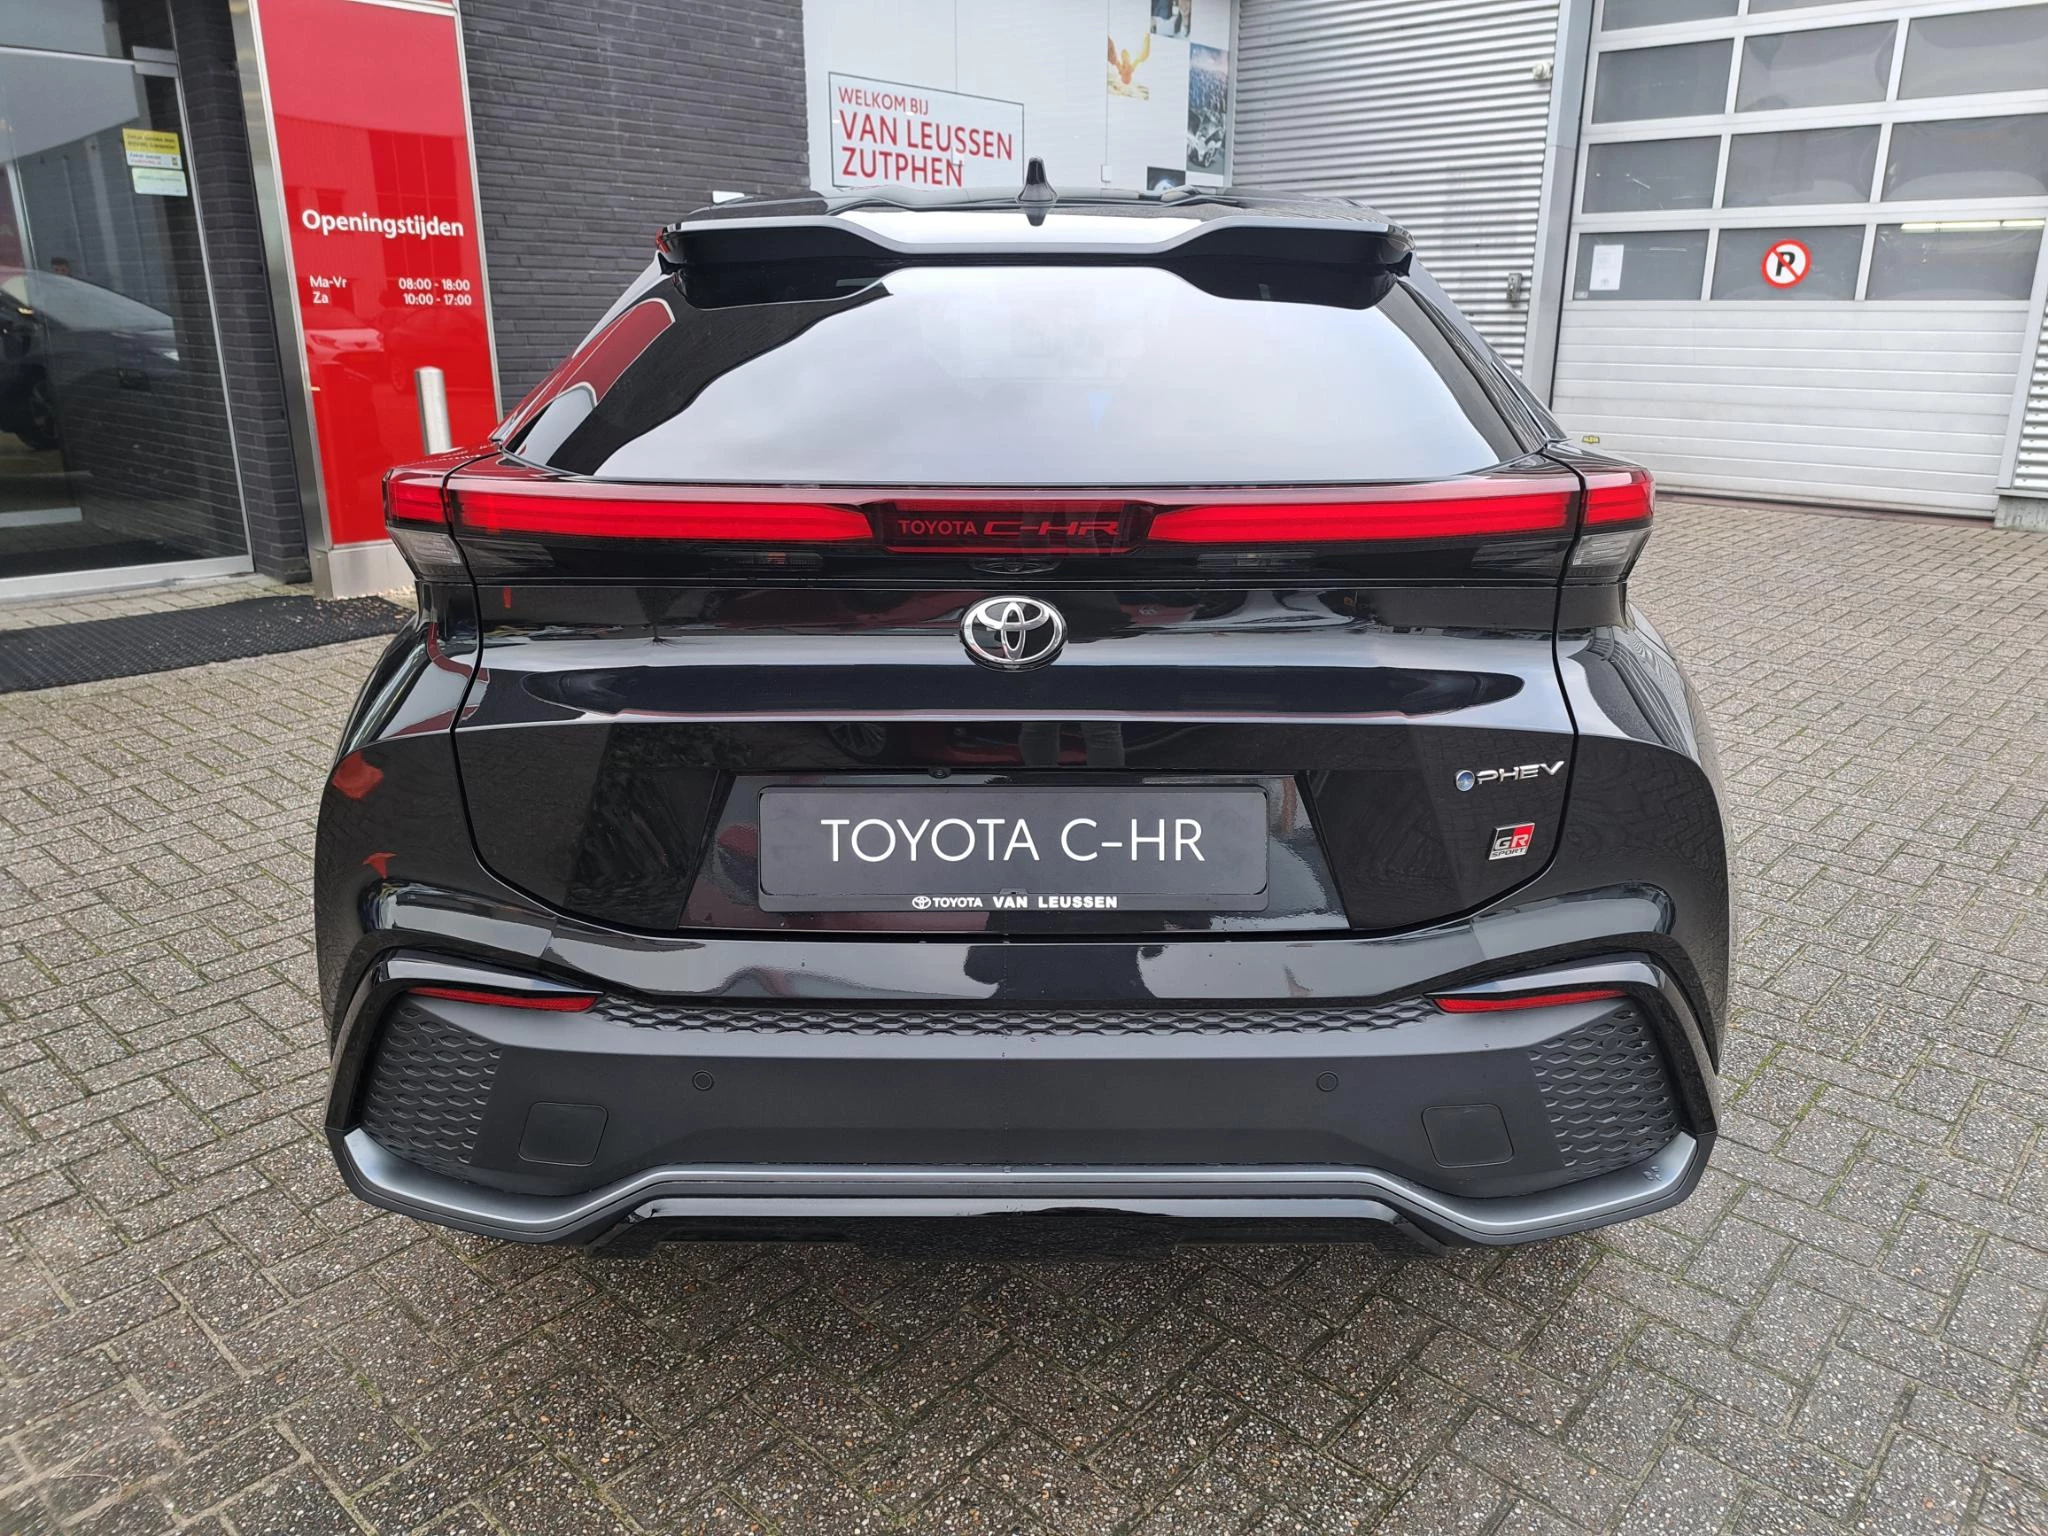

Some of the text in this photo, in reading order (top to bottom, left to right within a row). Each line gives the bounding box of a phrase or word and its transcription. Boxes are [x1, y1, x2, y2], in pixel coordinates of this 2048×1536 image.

[838, 86, 929, 116] WELKOM BIJ
[839, 110, 1013, 161] VAN LEUSSEN
[842, 146, 964, 188] ZUTPHEN
[302, 208, 465, 240] Openingstijden
[309, 275, 347, 289] Ma-Vr
[398, 277, 432, 290] 08:00
[441, 279, 471, 291] 18:00
[312, 291, 329, 304] Za
[403, 292, 434, 305] 10:00
[444, 294, 472, 305] 17:00
[897, 519, 1120, 537] TOYOTA C-HR
[1476, 760, 1565, 785] PHEV
[820, 817, 1206, 862] TOYOTA C-HR
[1493, 834, 1529, 850] GR
[1491, 848, 1526, 858] SPORT
[932, 895, 1118, 908] TOYOTA VAN LEUSSEN
